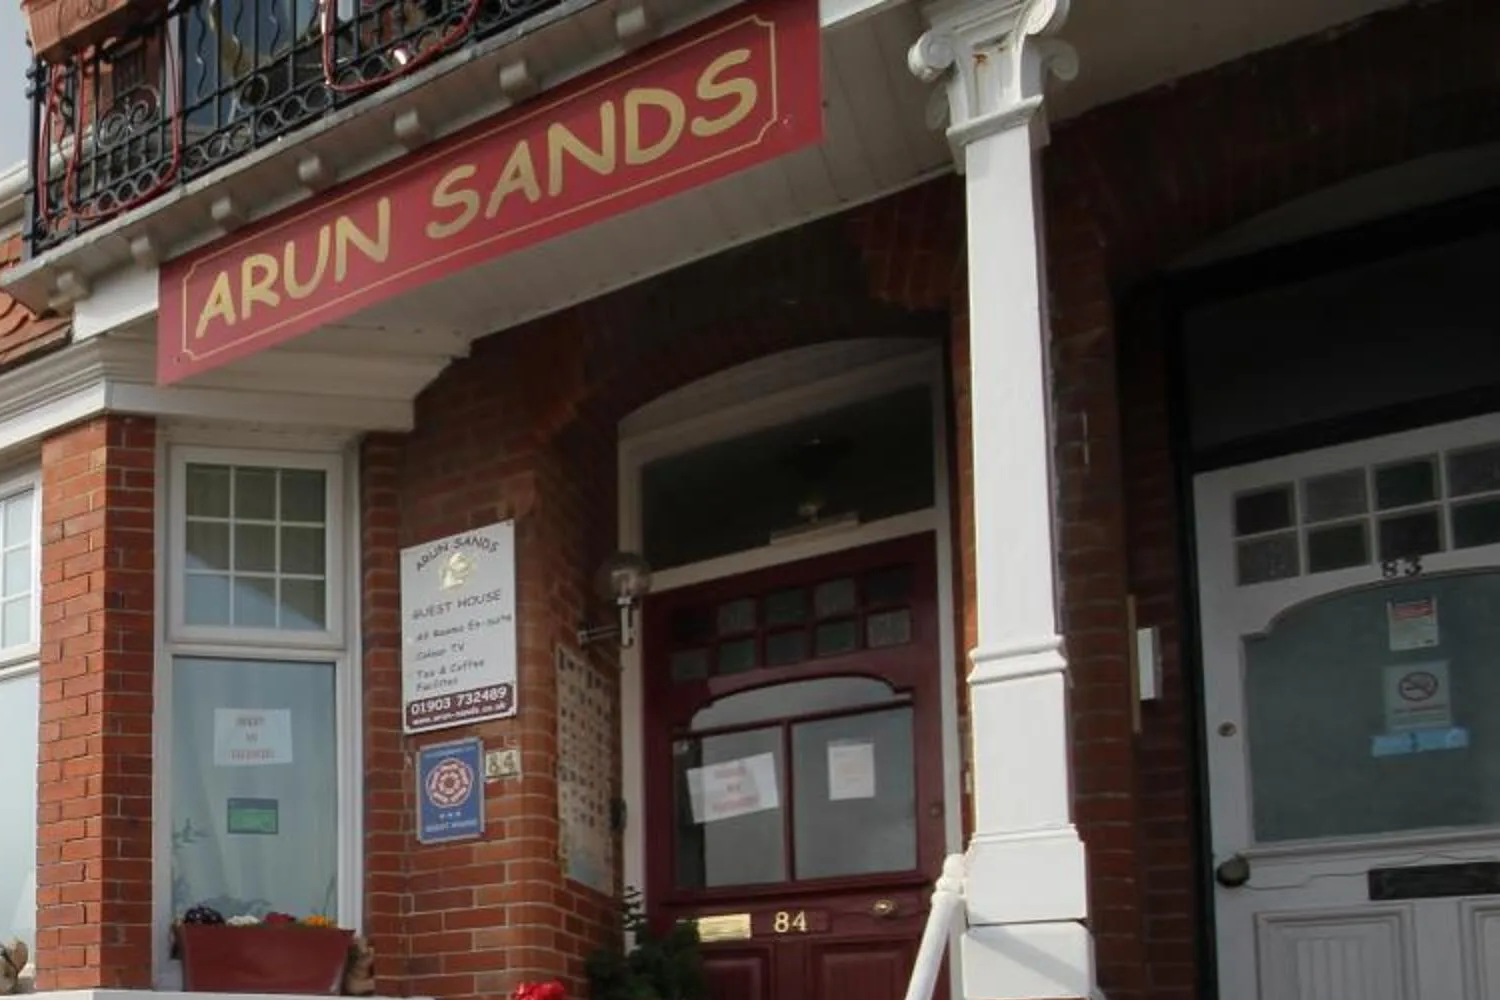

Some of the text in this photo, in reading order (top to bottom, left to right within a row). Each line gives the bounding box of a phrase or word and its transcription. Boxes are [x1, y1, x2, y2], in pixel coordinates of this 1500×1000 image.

[195, 48, 759, 339] ARUN SANDS
[415, 536, 499, 572] ARUN SANDS
[411, 588, 501, 619] GUEST HOUSE
[411, 686, 507, 716] 01903 732489
[775, 910, 807, 933] 84
